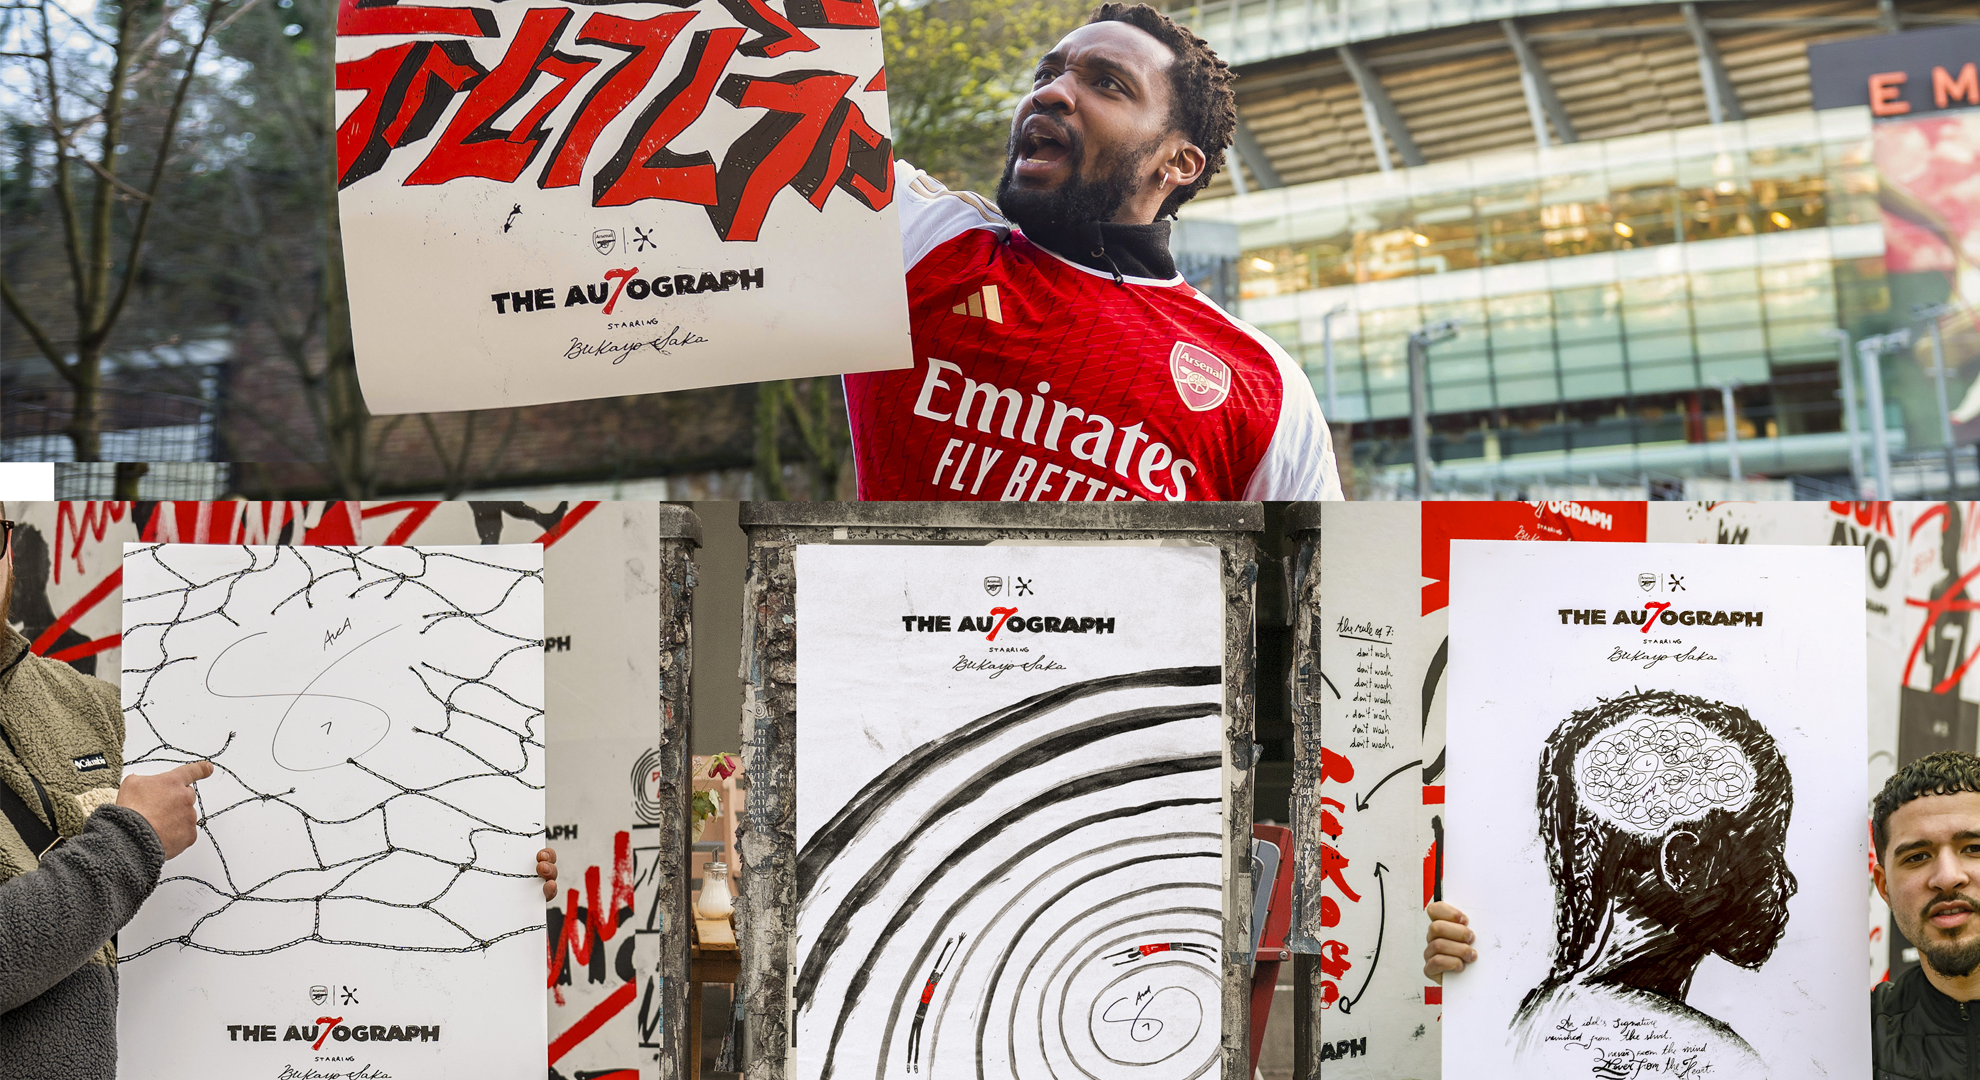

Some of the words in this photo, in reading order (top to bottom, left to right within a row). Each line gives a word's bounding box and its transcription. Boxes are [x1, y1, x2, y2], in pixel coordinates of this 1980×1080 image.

[491, 288, 556, 314] THE
[607, 318, 659, 330] STARRING
[649, 325, 709, 351] Saka
[1180, 352, 1222, 380] Arsenal
[914, 357, 1197, 500] Emirates
[932, 438, 1003, 495] FLY
[1000, 455, 1148, 500] BETT
[1537, 523, 1562, 535] STARRING
[902, 615, 952, 633] THE
[1558, 608, 1606, 625] THE
[1336, 616, 1353, 634] the
[1354, 622, 1374, 636] rule
[1673, 645, 1718, 663] Saka
[1020, 654, 1067, 673] Saka
[1357, 662, 1373, 674] don't
[1354, 677, 1372, 688] don't
[1353, 692, 1372, 702] don't
[227, 1024, 277, 1042] THE
[1620, 1030, 1641, 1042] the
[1661, 1041, 1677, 1055] the
[1682, 1043, 1708, 1053] mind
[345, 1063, 393, 1079] Saka
[1663, 1057, 1680, 1075] the
